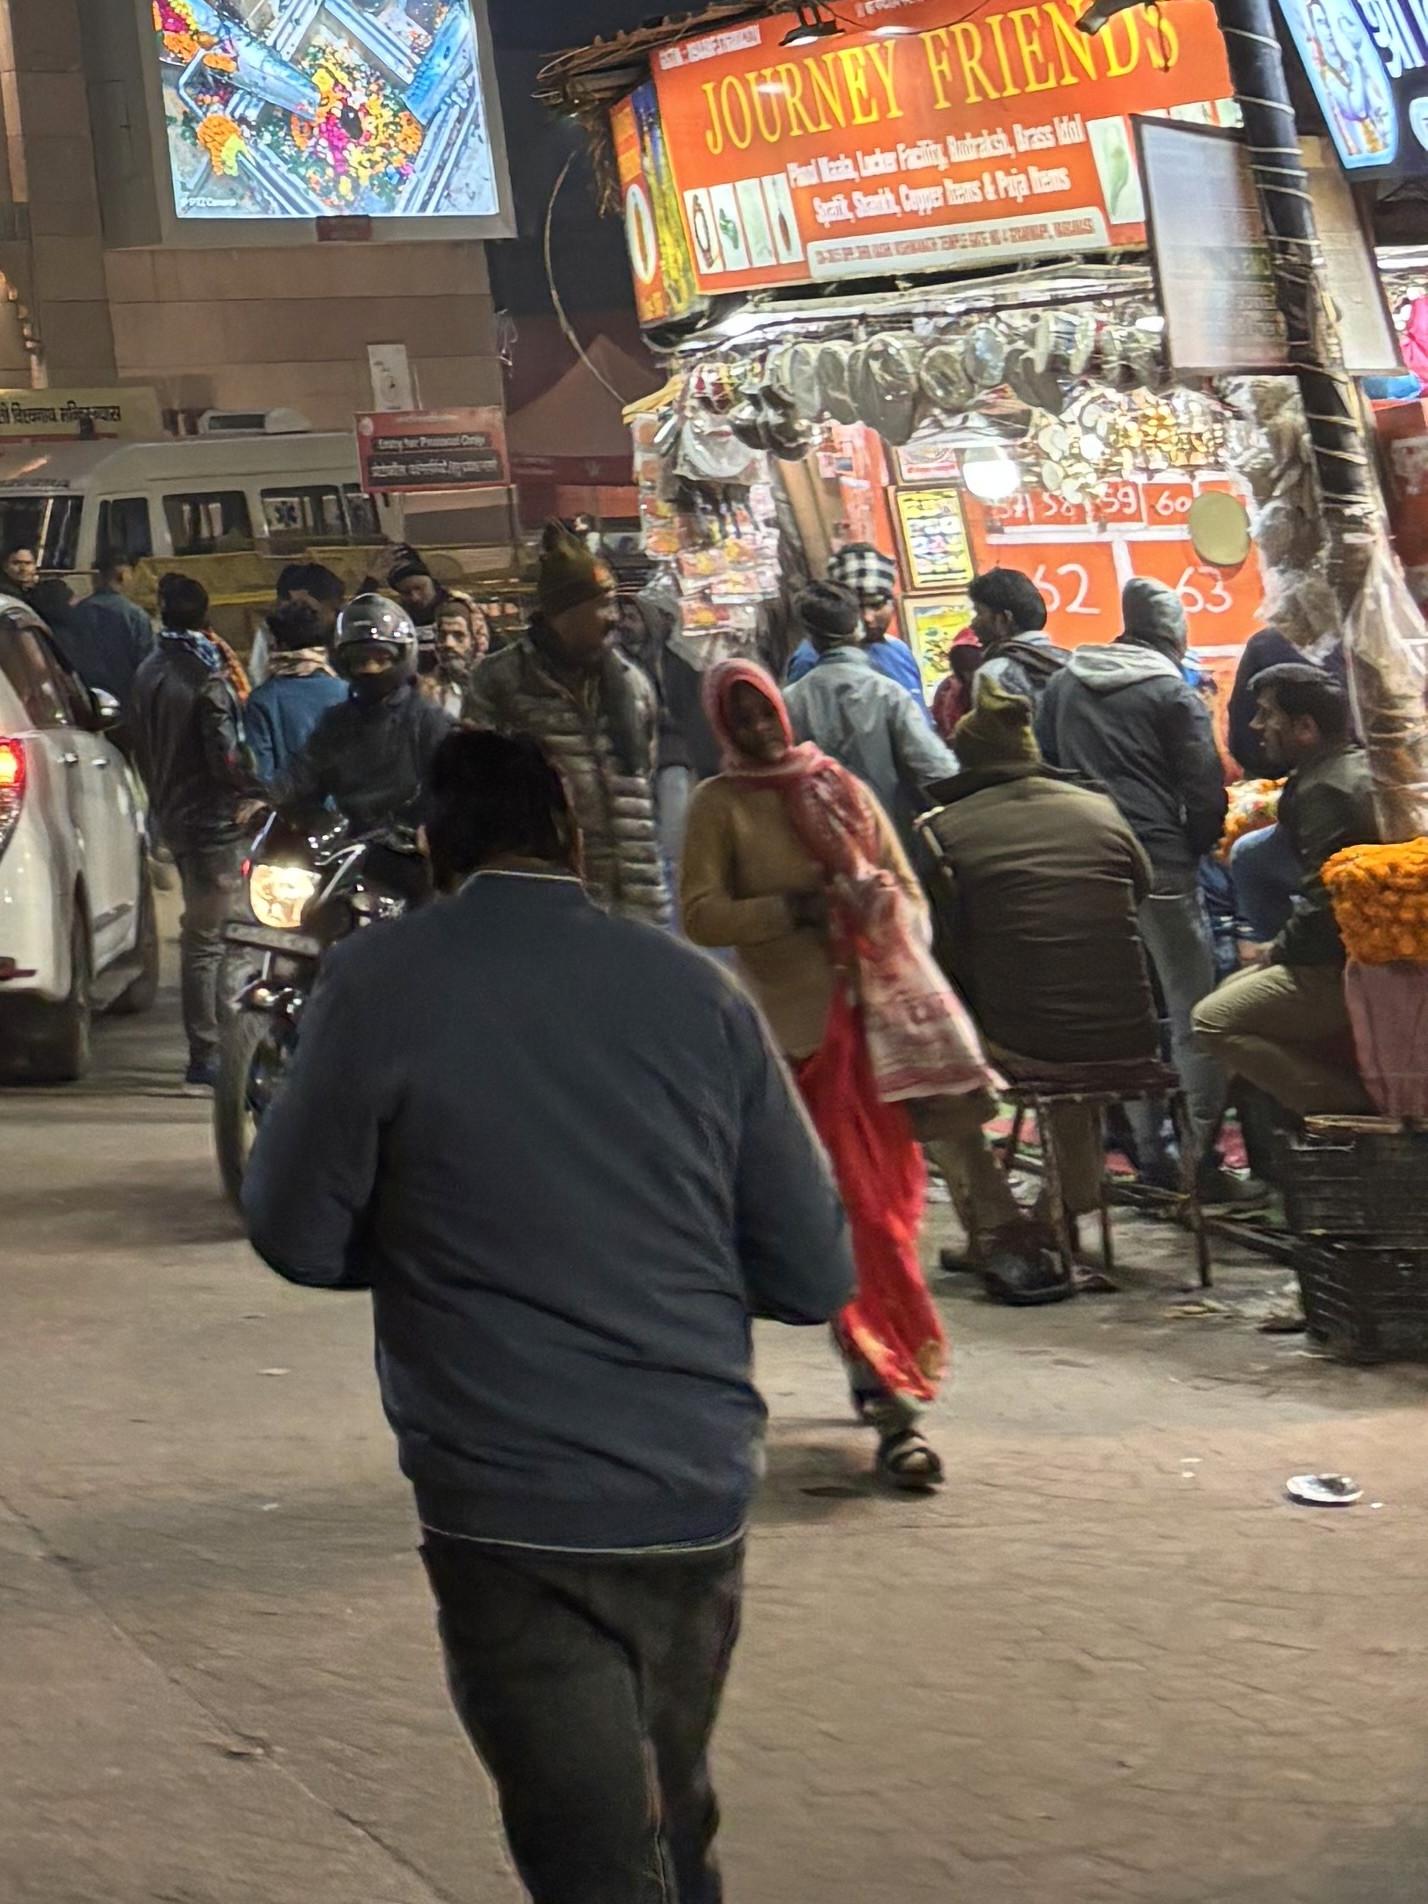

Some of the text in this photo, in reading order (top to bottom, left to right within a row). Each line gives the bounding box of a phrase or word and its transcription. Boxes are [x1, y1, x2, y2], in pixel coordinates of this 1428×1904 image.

[701, 39, 904, 155] JOURNEY
[1100, 486, 1136, 515] 59
[1154, 490, 1193, 515] 60
[1033, 563, 1234, 614] 62 63
